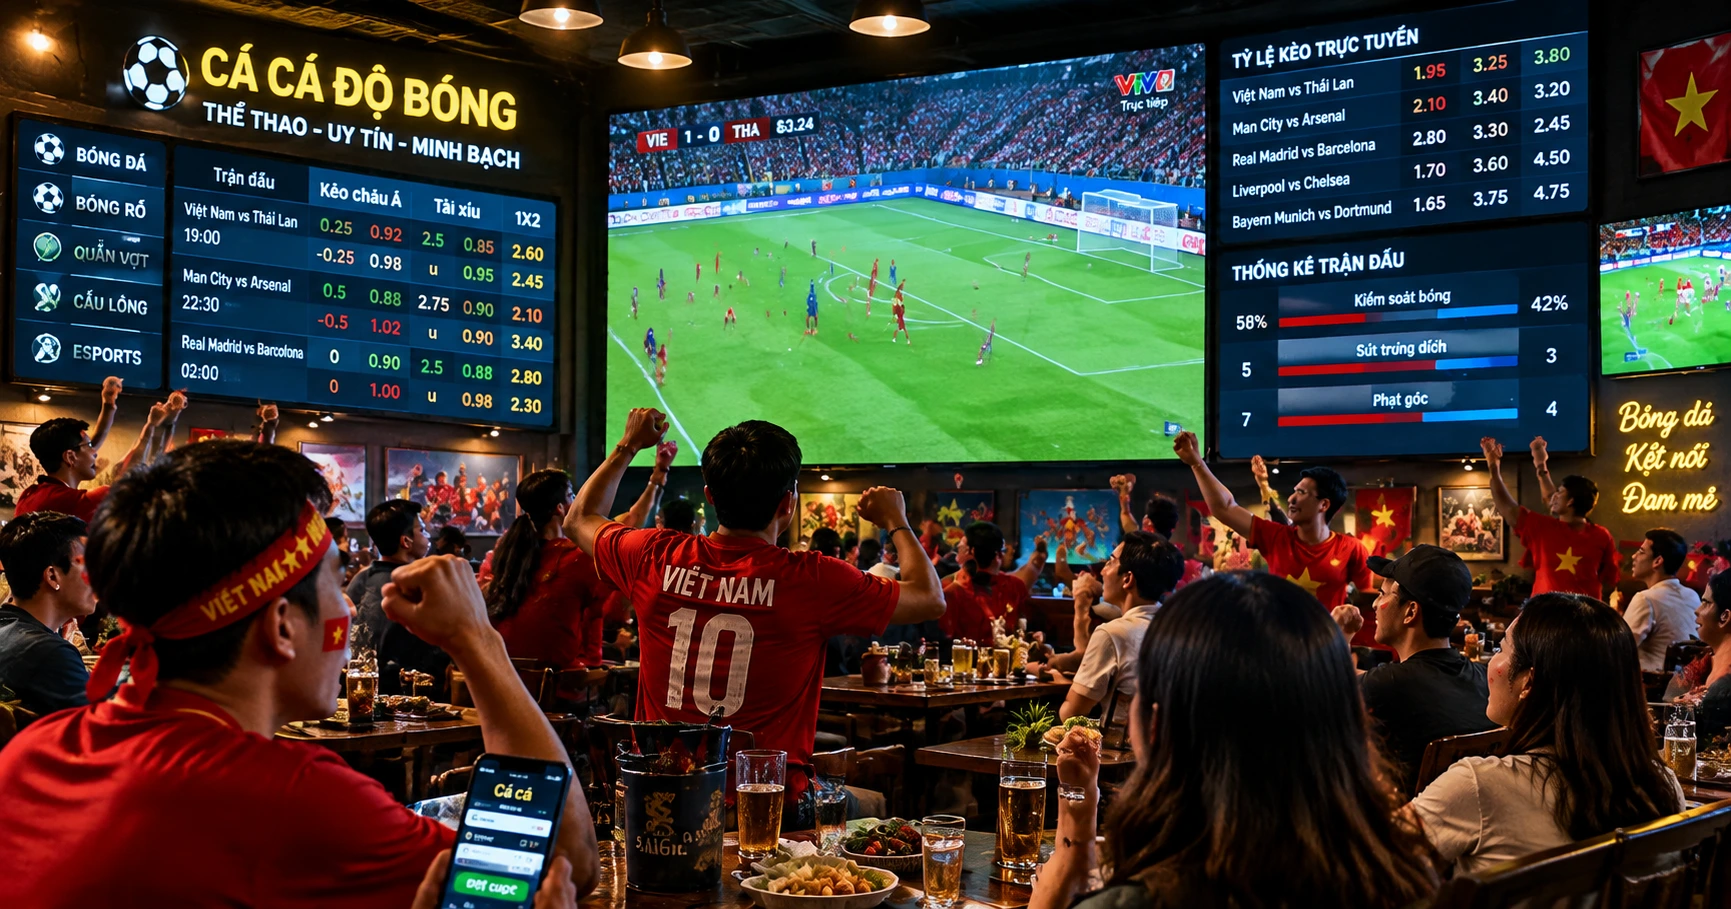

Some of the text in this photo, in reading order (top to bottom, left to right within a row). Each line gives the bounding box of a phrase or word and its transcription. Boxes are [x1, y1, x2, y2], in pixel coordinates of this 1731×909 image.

[1256, 44, 1275, 69] LỆ
[1278, 41, 1311, 63] KÈO
[1315, 36, 1360, 59] TRỰC
[200, 42, 517, 131] CÁ CÁ ĐỘ BÓNG
[1258, 84, 1285, 101] Nam
[1288, 86, 1301, 97] vs
[1304, 79, 1330, 96] Thái
[1332, 77, 1354, 91] Lan
[1413, 63, 1446, 80] 1.95
[1473, 54, 1508, 73] 3.25
[1534, 46, 1571, 65] 3.80
[1232, 80, 1571, 136] Man City vs Arsenal 2.10 3.40 3.20
[250, 110, 308, 137] THAO
[327, 122, 355, 144] UY
[360, 127, 394, 151] TÍN
[412, 136, 462, 162] MINH
[467, 147, 521, 170] BẠCH
[646, 132, 668, 148] VIE
[684, 130, 692, 144] 1
[708, 125, 720, 143] 0
[732, 122, 760, 139] THA
[1232, 114, 1571, 167] Real Madrid vs Barcelona 2.80 3.30 2.45
[76, 146, 147, 172] BÓNG ĐÁ
[213, 166, 245, 187] Trận
[1232, 148, 1571, 198] Liverpool vs Chelsea 1.70 3.60 4.50
[75, 194, 120, 215] BÓNG
[210, 205, 235, 221] Nam
[238, 212, 250, 222] vs
[278, 213, 298, 228] Lan
[1232, 182, 1571, 230] Bayern Munich vs Dortmund 1.65 3.75 4.75
[515, 210, 541, 228] 1X2
[184, 227, 221, 245] 19:00
[320, 217, 544, 262] 0.25 0.92 2.5 0.85 2.60
[316, 247, 544, 290] -0.25 0.98 u 0.95 2.45
[1231, 258, 1289, 282] THỐNG
[1318, 252, 1365, 277] TRẬN
[183, 268, 292, 293] Man City vs Arsenal
[182, 294, 220, 313] 22:30
[323, 282, 543, 324] 0.5 0.88 2.75 0.90 2.10
[1418, 288, 1452, 305] bóng
[1530, 294, 1569, 312] 42%
[317, 313, 543, 352] -0.5 1.02 u 0.90 3.40
[1236, 314, 1268, 331] 58%
[73, 344, 142, 365] ESPORTS
[182, 334, 206, 352] Real
[207, 337, 243, 355] Madrid
[243, 343, 256, 355] vs
[1545, 347, 1557, 364] 3
[181, 362, 219, 381] 02:00
[329, 348, 542, 386] 0 0.90 2.5 0.88 2.80
[1241, 361, 1252, 378] 5
[329, 379, 542, 414] 0 1.00 u 0.98 2.30
[1372, 391, 1429, 410] Phạt góc
[1545, 400, 1558, 417] 4
[1241, 412, 1252, 428] 7
[1622, 481, 1679, 514] Đam
[715, 576, 776, 607] NAM
[665, 606, 755, 718] 10
